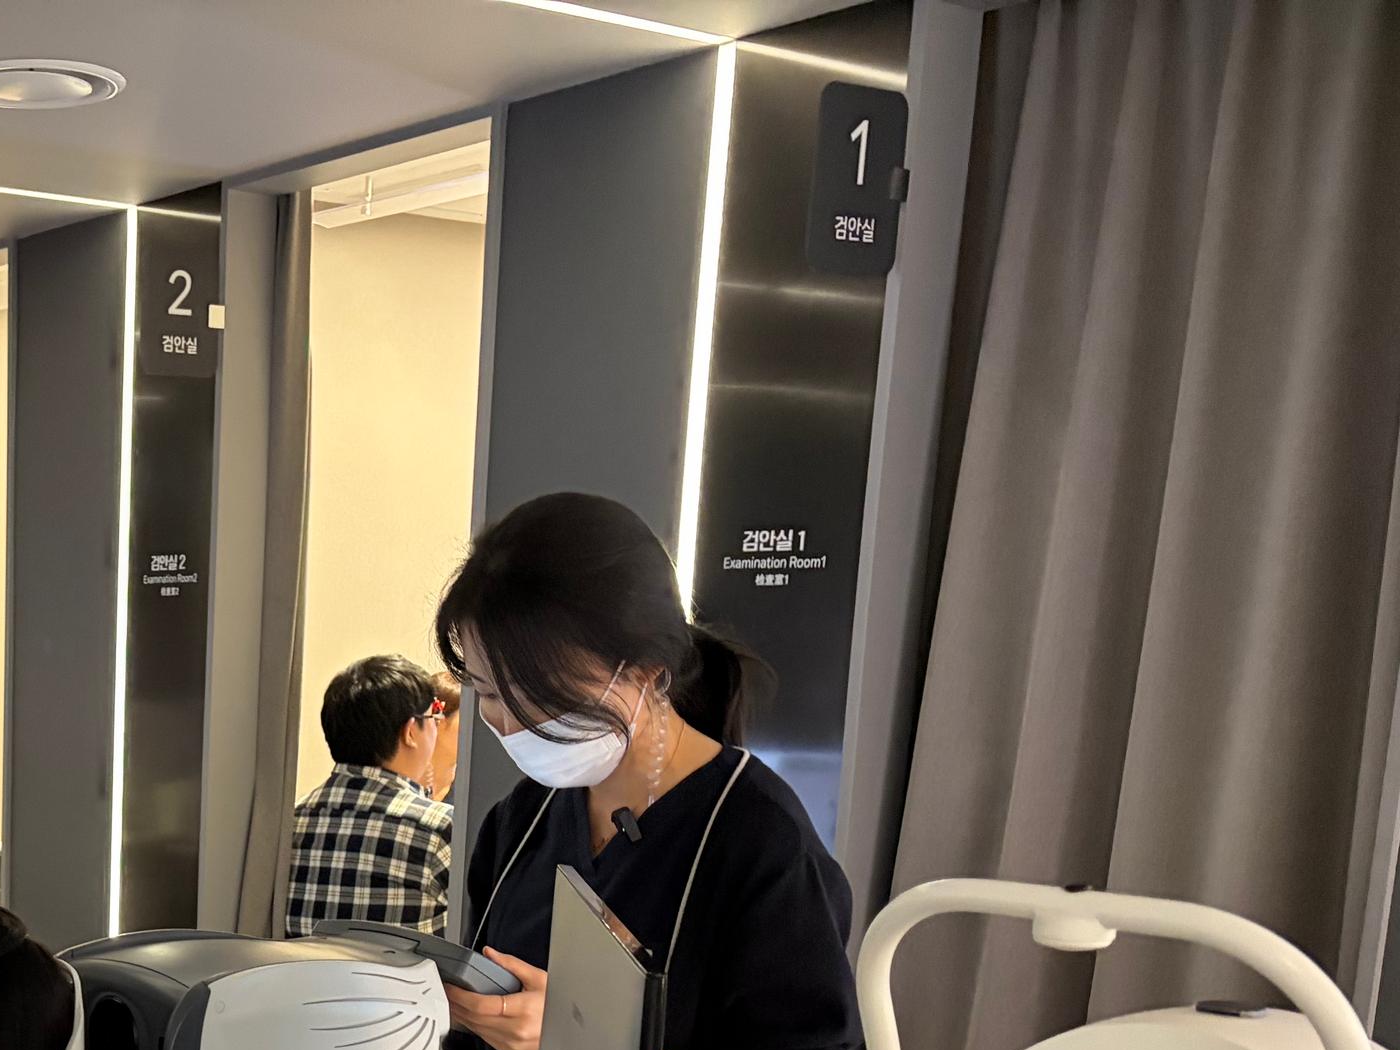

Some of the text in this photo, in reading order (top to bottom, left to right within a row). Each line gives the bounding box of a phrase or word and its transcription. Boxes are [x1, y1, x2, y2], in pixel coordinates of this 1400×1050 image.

[850, 119, 870, 186] 1
[834, 215, 876, 243] 검안실
[167, 269, 193, 317] 2
[161, 334, 198, 355] 검안실
[742, 528, 806, 553] 검안실 1
[150, 553, 187, 572] 검안실 2
[723, 554, 827, 570] Examination Room1
